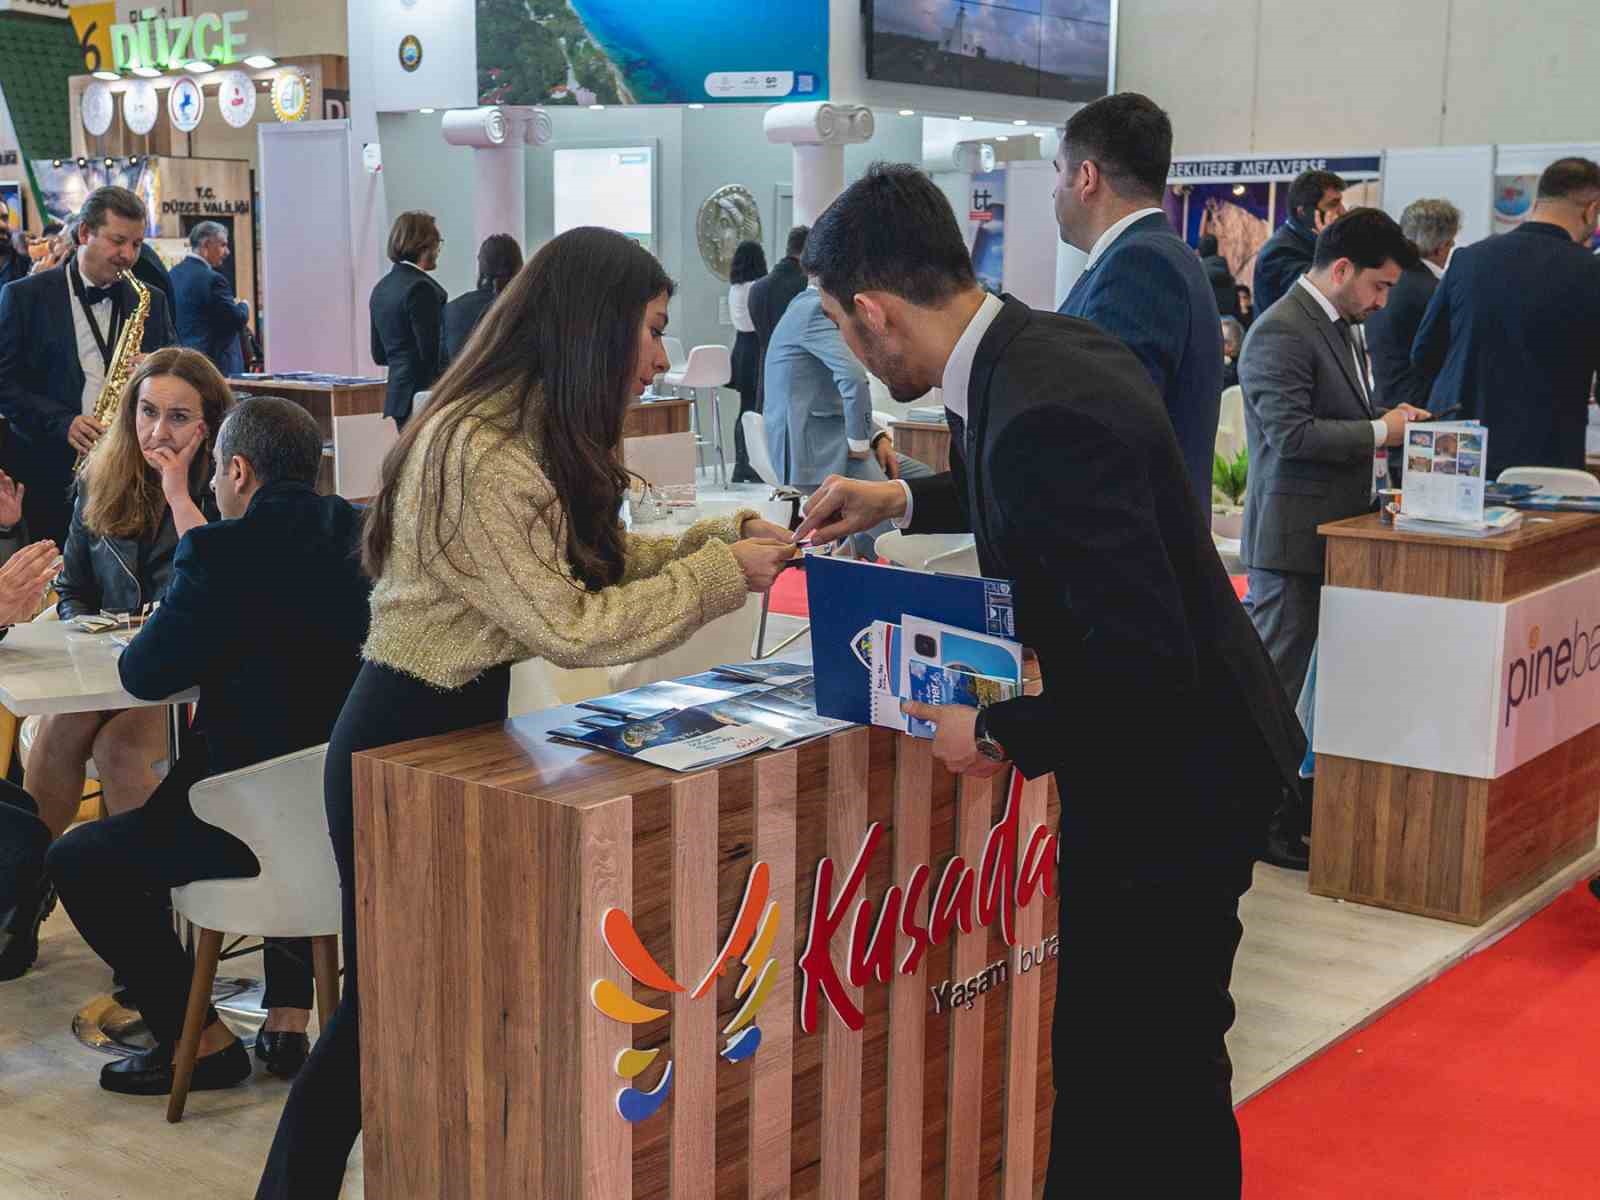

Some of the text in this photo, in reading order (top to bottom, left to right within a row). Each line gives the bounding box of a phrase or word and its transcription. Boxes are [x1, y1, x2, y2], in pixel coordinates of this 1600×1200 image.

[1240, 159, 1327, 176] METAVERSE
[162, 199, 201, 214] DÜZCE
[930, 959, 1008, 1014] Yaşam
